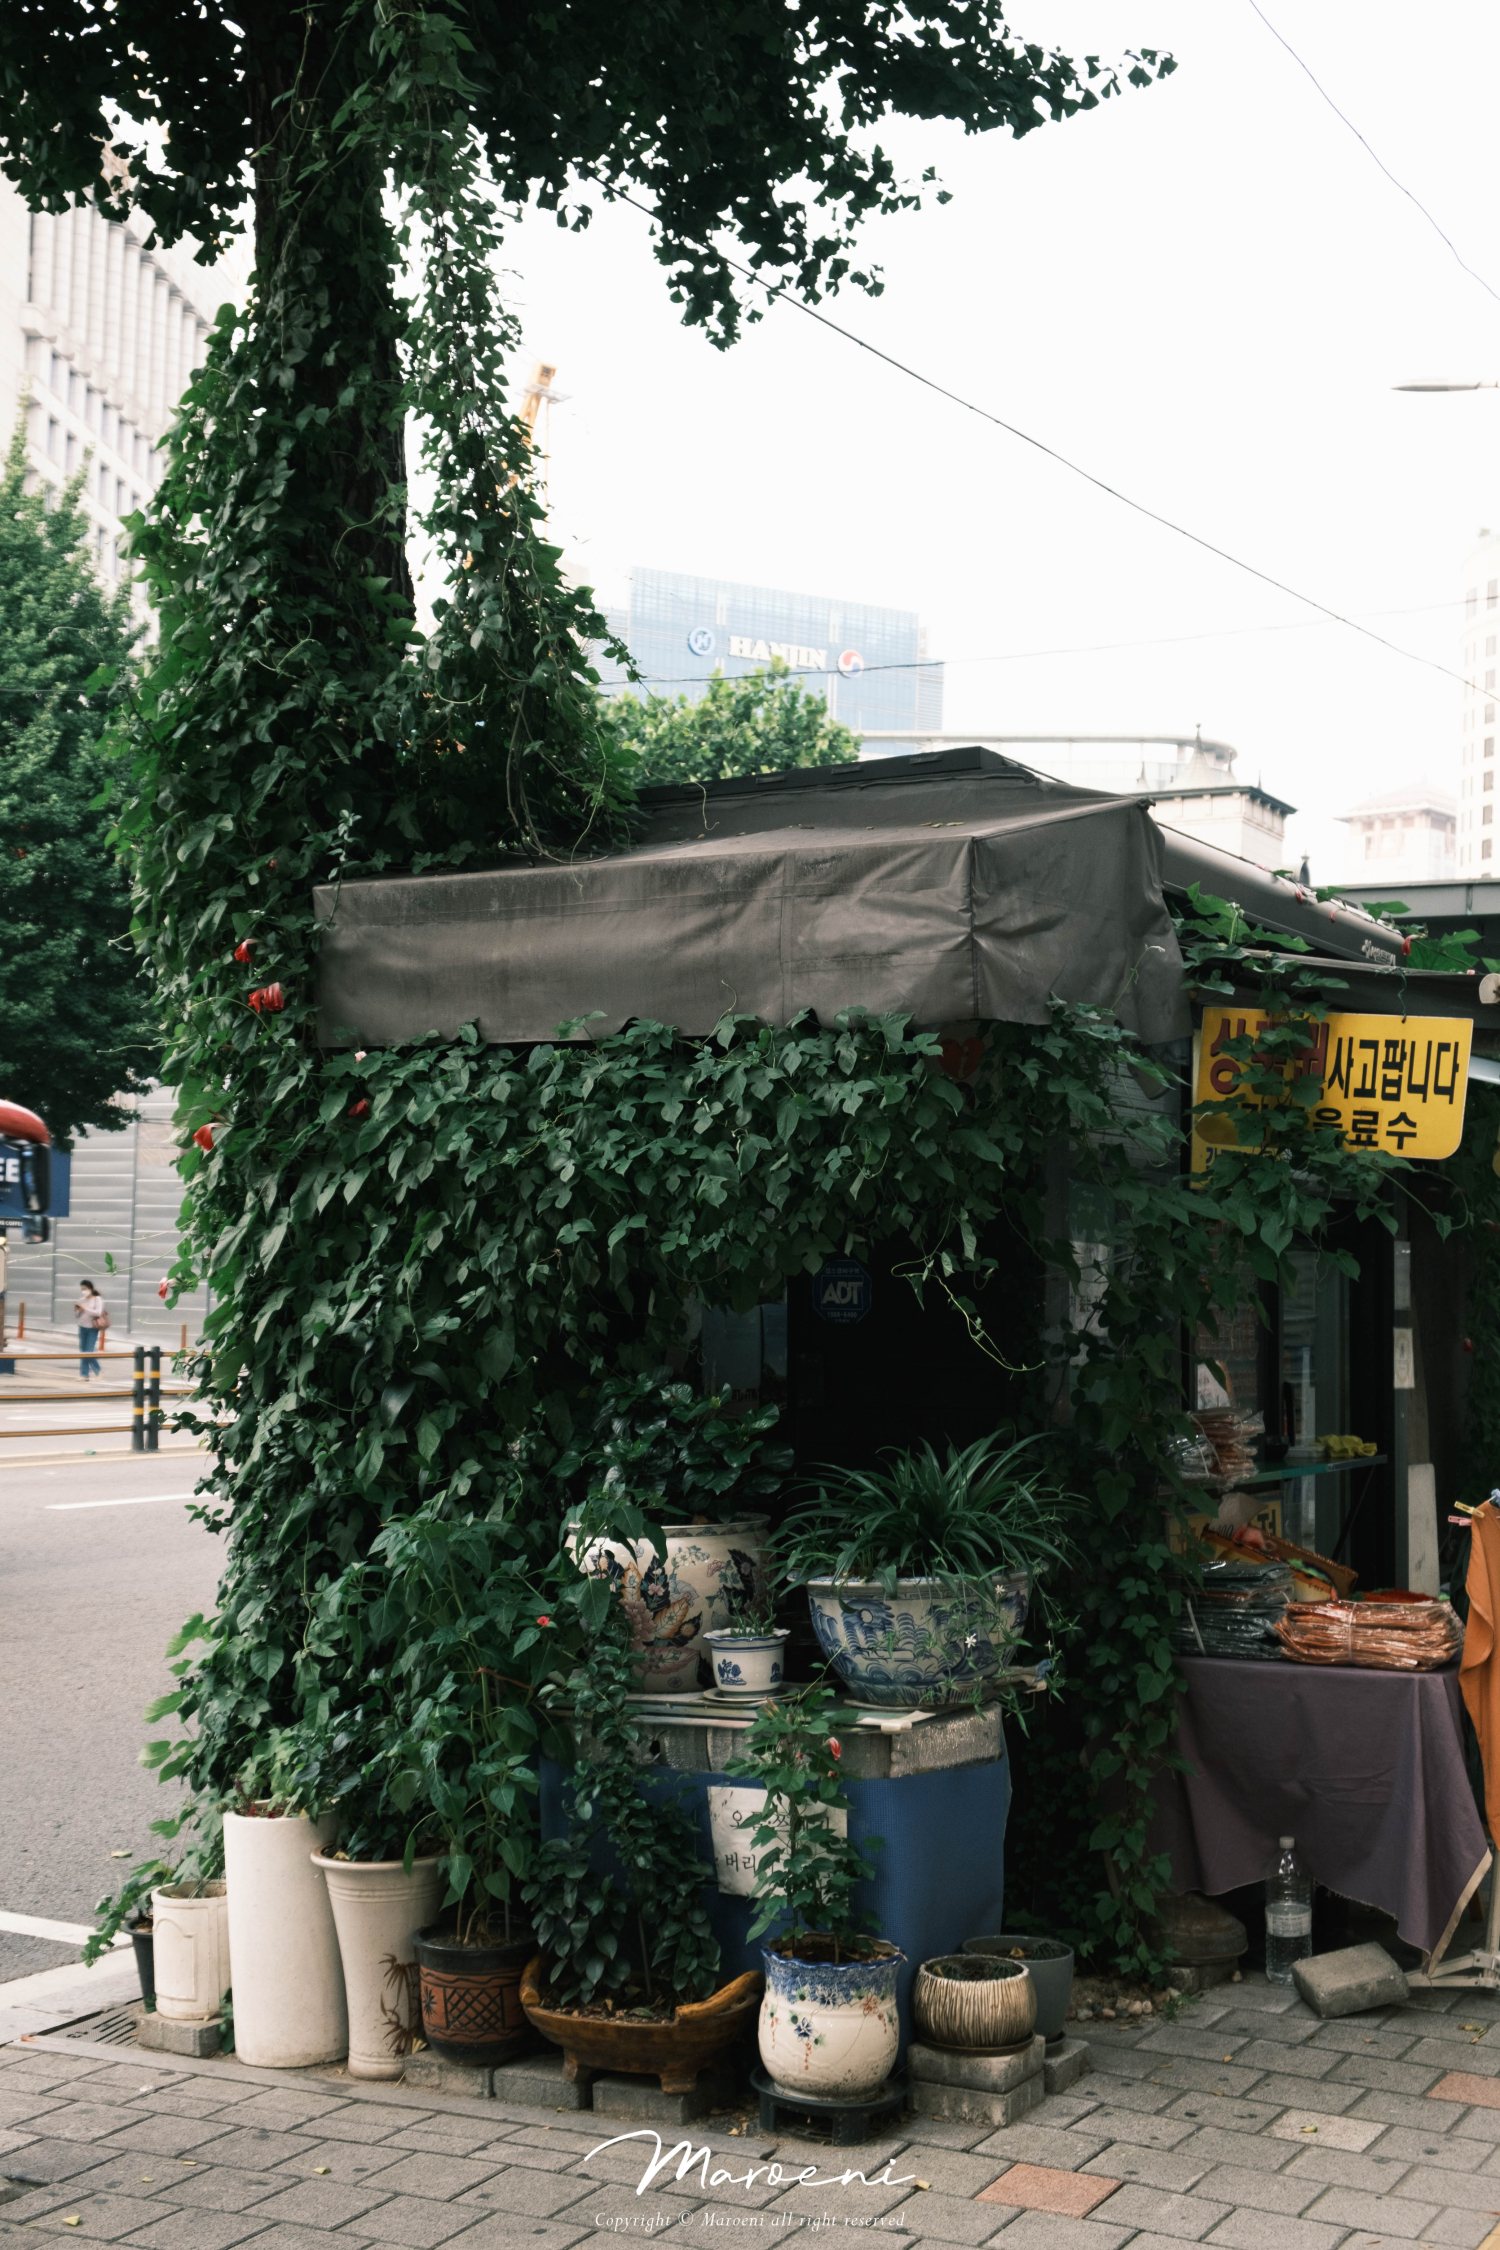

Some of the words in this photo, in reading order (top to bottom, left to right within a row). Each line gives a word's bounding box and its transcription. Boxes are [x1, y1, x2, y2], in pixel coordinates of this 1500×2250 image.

[728, 634, 828, 670] HANJIN
[1327, 1035, 1460, 1105] 사고팝니다
[821, 1281, 863, 1305] ADT
